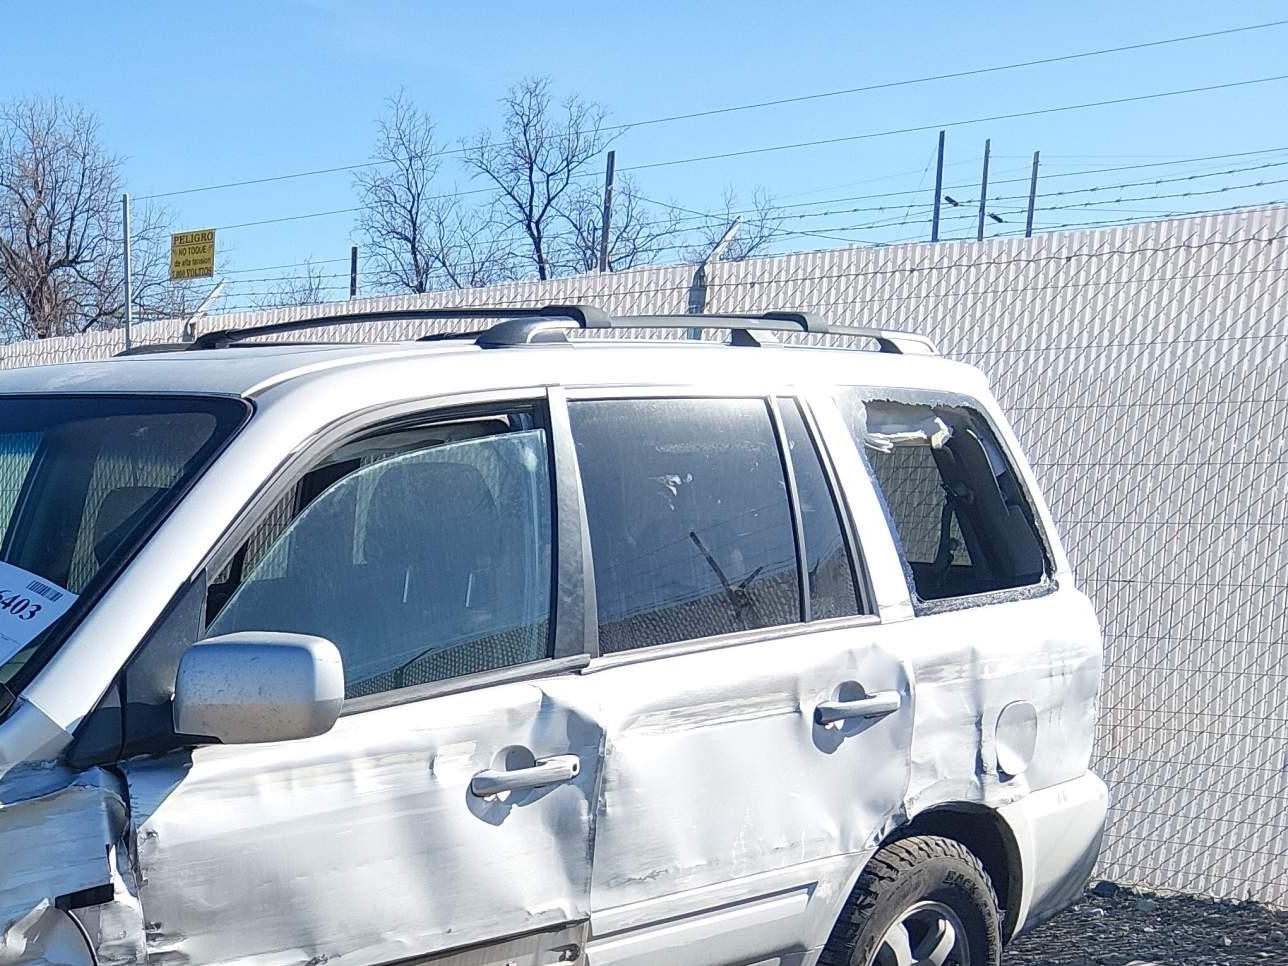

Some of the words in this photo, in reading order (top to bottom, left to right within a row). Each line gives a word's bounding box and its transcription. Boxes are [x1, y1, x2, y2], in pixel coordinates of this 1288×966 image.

[173, 232, 214, 245] PELIGRO
[178, 247, 187, 256] NO
[188, 245, 207, 255] TOQUE
